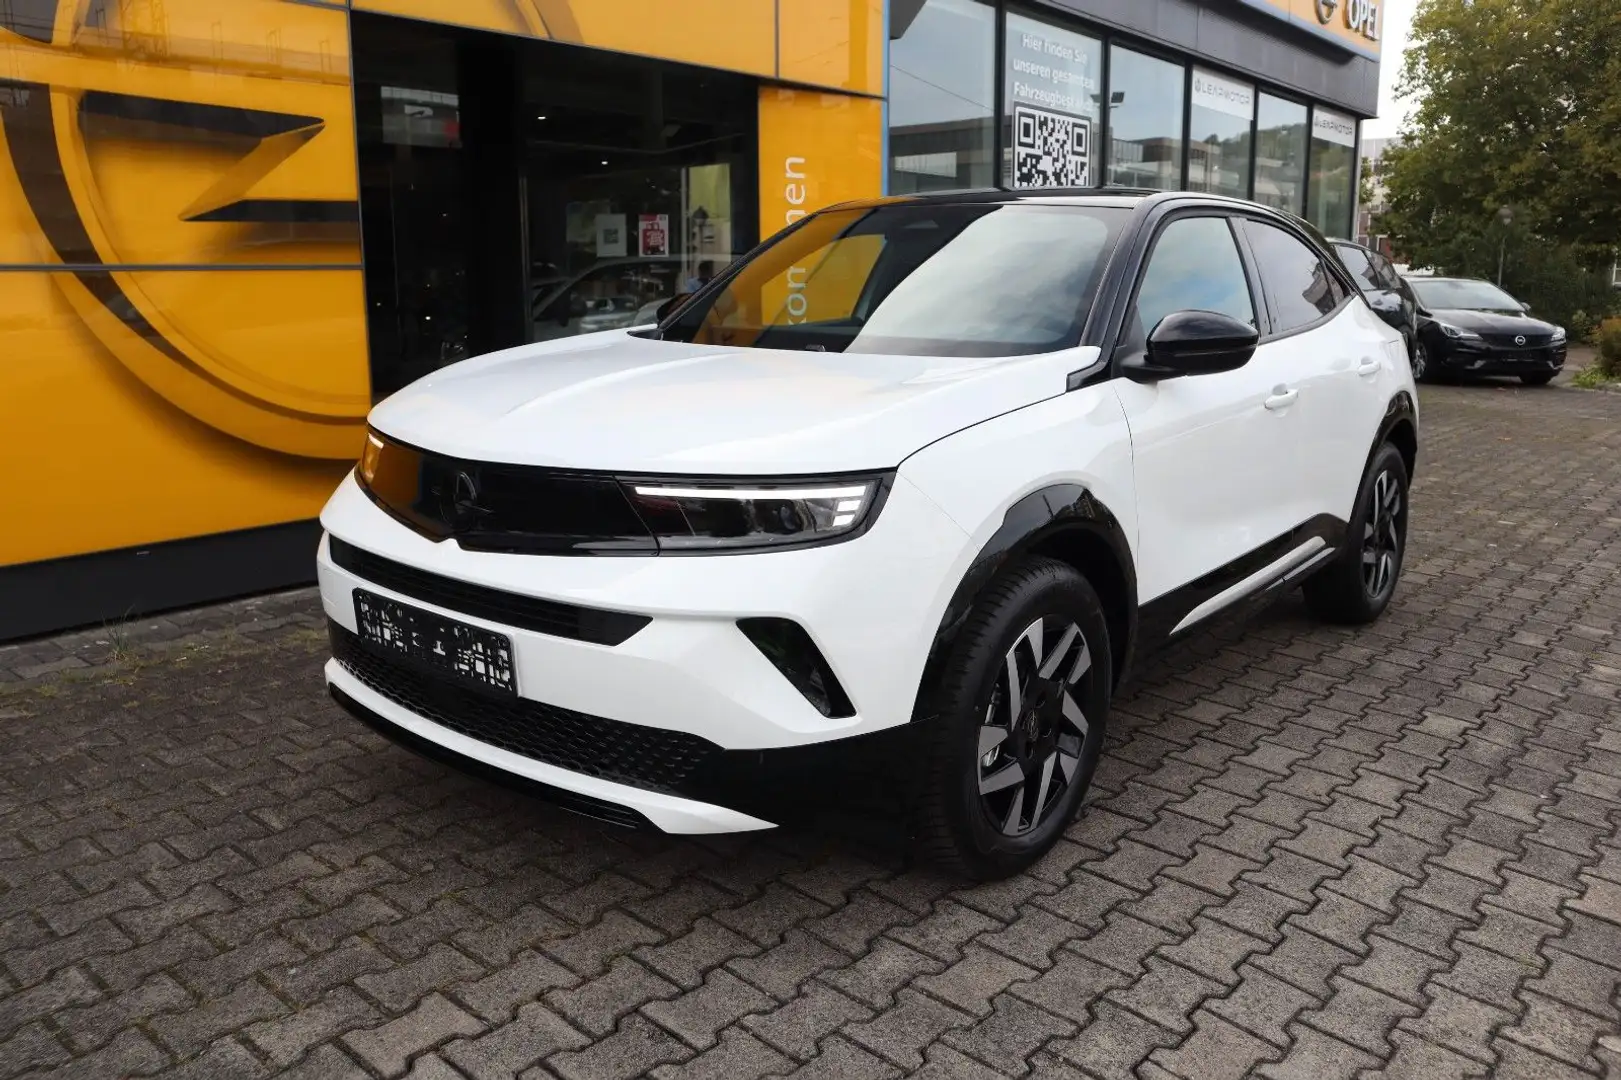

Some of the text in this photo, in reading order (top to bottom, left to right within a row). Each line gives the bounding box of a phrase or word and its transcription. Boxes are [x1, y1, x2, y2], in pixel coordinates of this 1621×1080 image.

[1347, 0, 1380, 39] OPEL
[1022, 33, 1043, 52] Hier
[1074, 49, 1088, 64] Sie
[1013, 58, 1095, 90] unseren gesten
[1014, 81, 1094, 111] Fahrzeugbes
